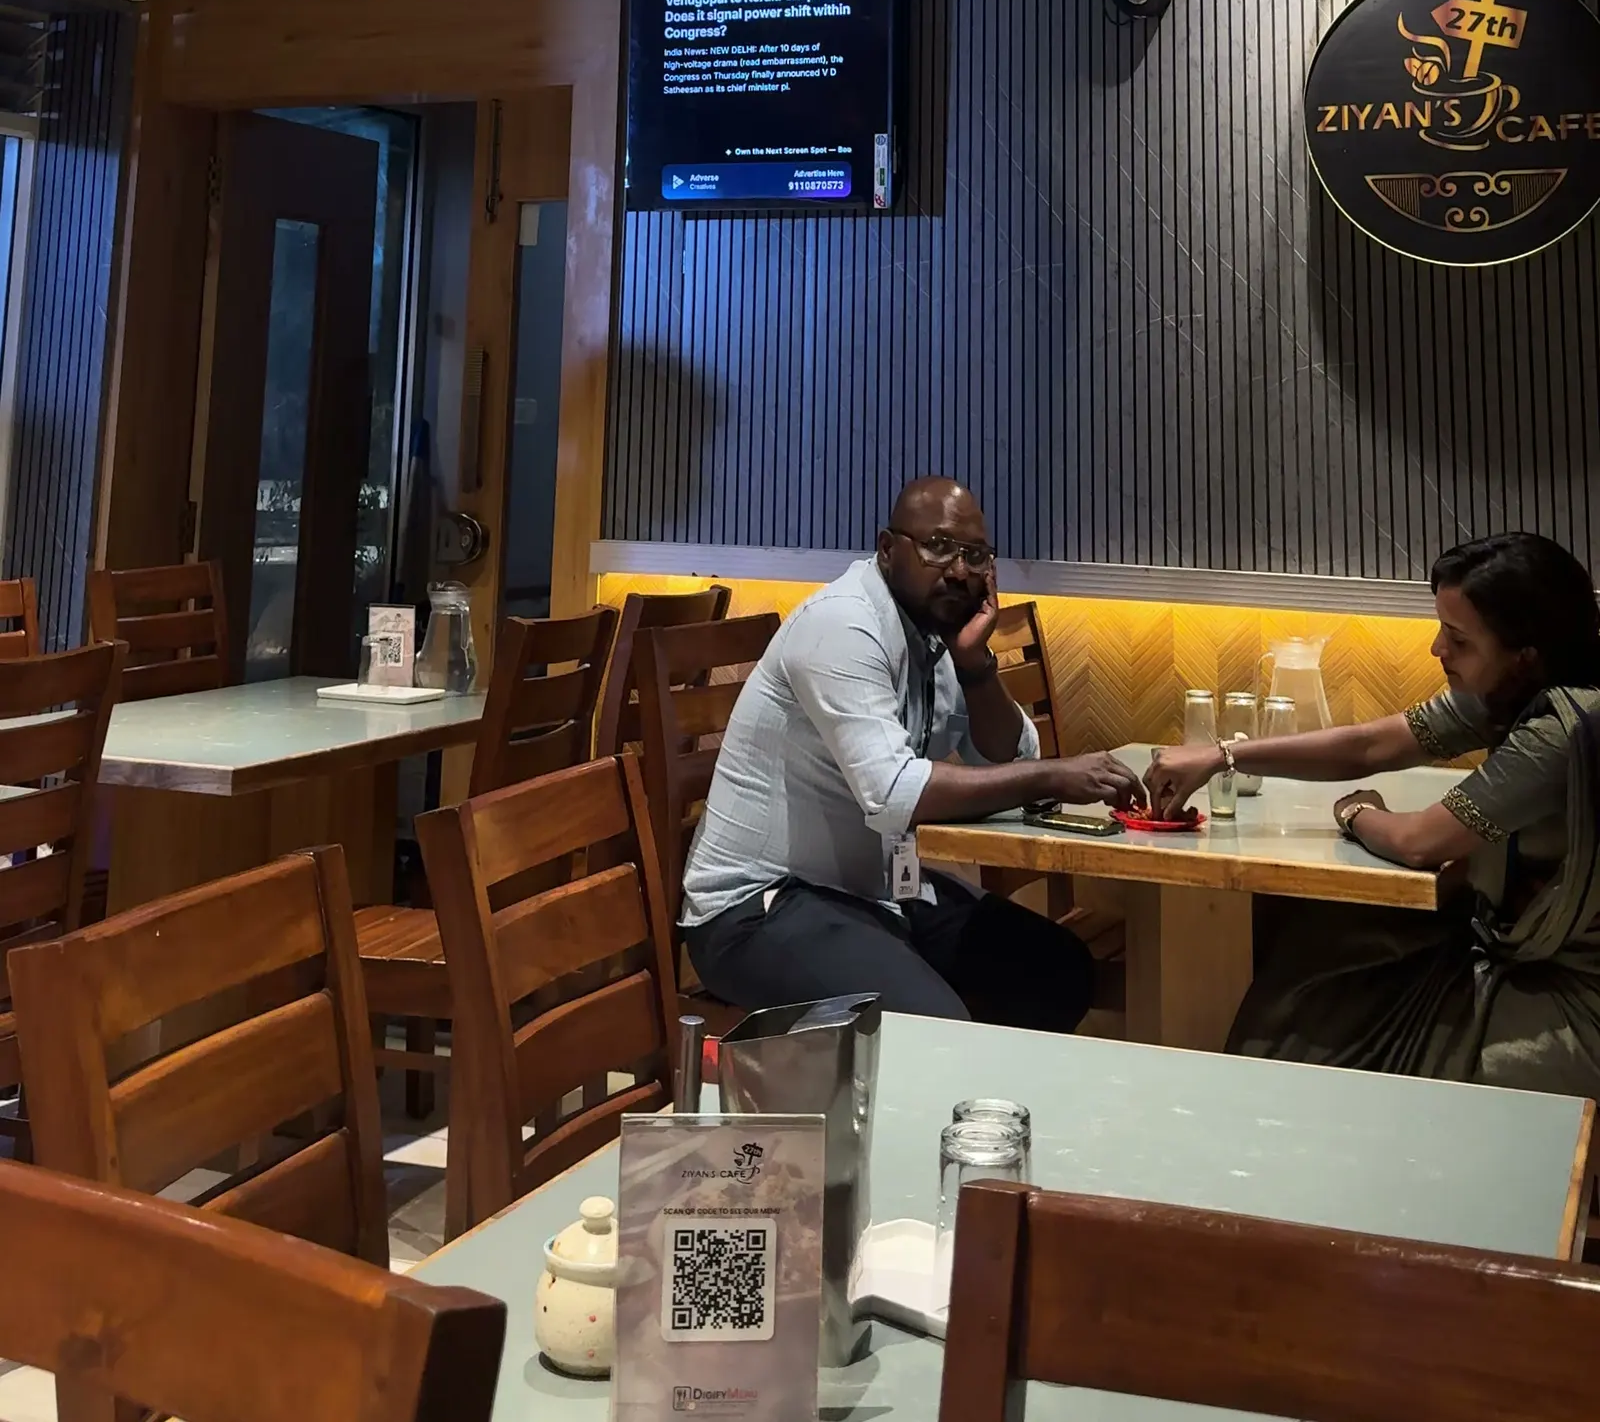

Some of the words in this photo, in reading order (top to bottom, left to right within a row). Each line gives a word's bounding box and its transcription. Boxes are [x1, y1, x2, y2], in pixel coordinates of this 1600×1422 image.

[665, 11, 695, 23] Does
[697, 10, 705, 21] it
[707, 8, 742, 23] signal
[744, 7, 782, 22] power
[784, 5, 811, 18] shift
[813, 3, 851, 16] within
[1445, 8, 1518, 40] 27th
[664, 25, 727, 41] Congress?
[664, 48, 682, 57] India
[684, 47, 708, 56] News:
[710, 47, 730, 55] NEW
[731, 46, 758, 54] DELHI:
[759, 45, 778, 53] After
[780, 44, 789, 52] 10
[791, 44, 810, 54] days
[811, 43, 820, 52] of
[664, 60, 712, 70] high-voltage
[713, 59, 738, 68] drama
[740, 57, 760, 68] (read
[762, 56, 828, 67] embarrassment),
[830, 55, 844, 64] the
[663, 72, 700, 83] Congress
[714, 71, 749, 82] Thursday
[751, 70, 775, 81] finally
[776, 69, 820, 78] announced
[821, 68, 829, 77] V
[830, 68, 837, 77] D
[663, 85, 703, 95] Satheesan
[704, 86, 714, 94] as
[716, 85, 725, 93] its
[727, 83, 746, 93] chief
[748, 83, 779, 92] minister
[1317, 99, 1462, 133] ZIYAN'S
[1496, 113, 1600, 144] CAFE
[735, 147, 751, 156] Own
[752, 147, 764, 155] the
[765, 147, 782, 155] Next
[784, 146, 809, 155] Screen
[810, 146, 827, 155] Spot
[794, 169, 826, 178] Advertise
[828, 169, 845, 177] Here
[720, 1170, 746, 1178] CAFE
